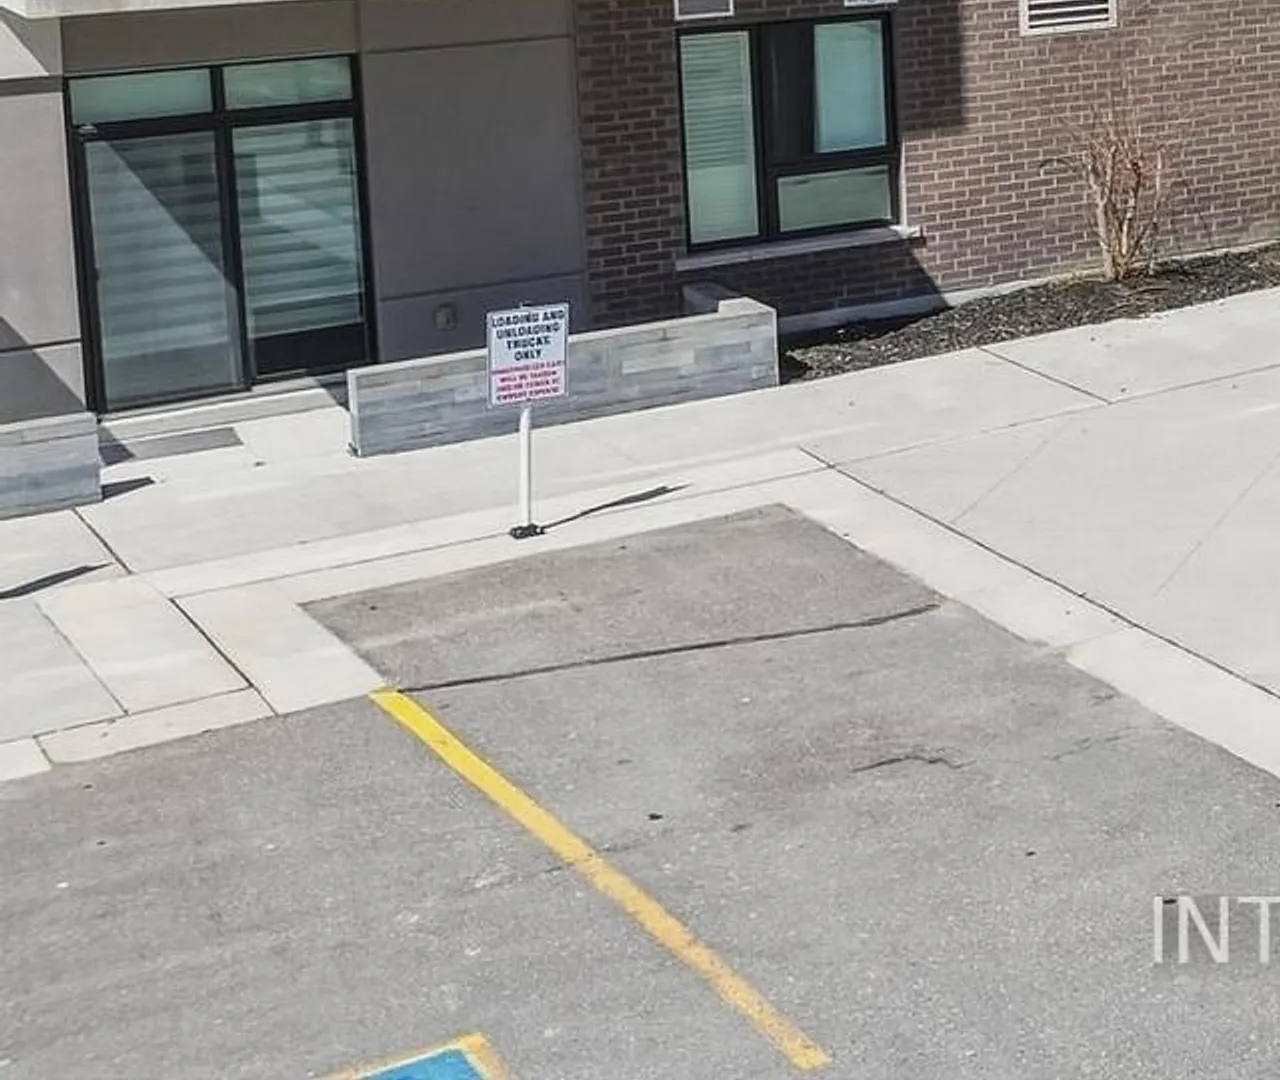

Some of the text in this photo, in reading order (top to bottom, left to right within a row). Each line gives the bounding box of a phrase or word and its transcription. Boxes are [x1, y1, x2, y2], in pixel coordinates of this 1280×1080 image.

[492, 309, 565, 327] LOADING AND
[496, 322, 560, 339] UNLOADING
[514, 349, 541, 361] ONLY
